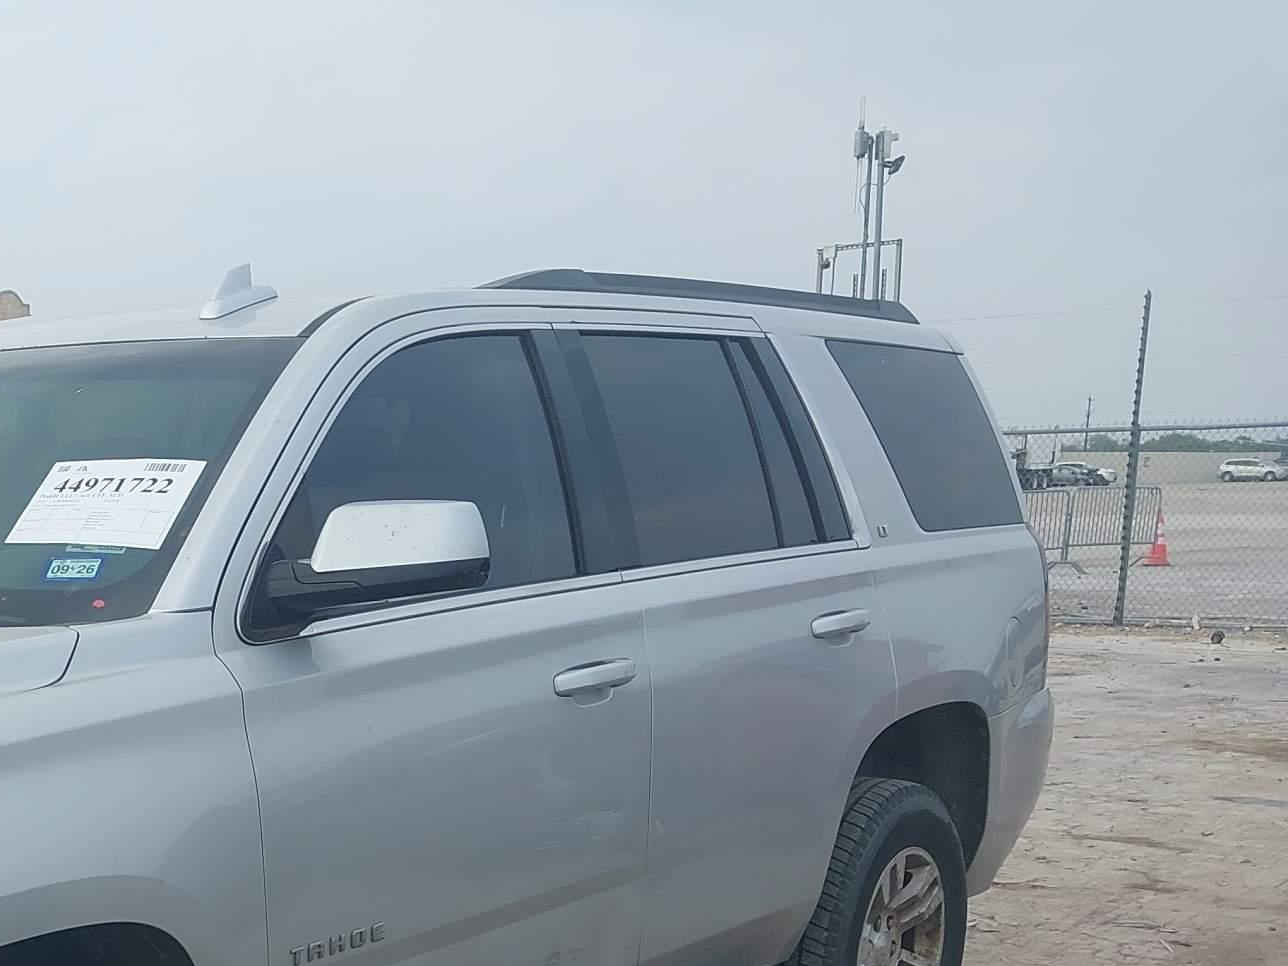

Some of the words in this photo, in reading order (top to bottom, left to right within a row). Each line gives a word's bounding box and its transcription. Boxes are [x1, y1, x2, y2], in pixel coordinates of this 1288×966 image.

[54, 477, 174, 494] 44971722
[51, 564, 70, 575] 09
[76, 564, 97, 575] 26
